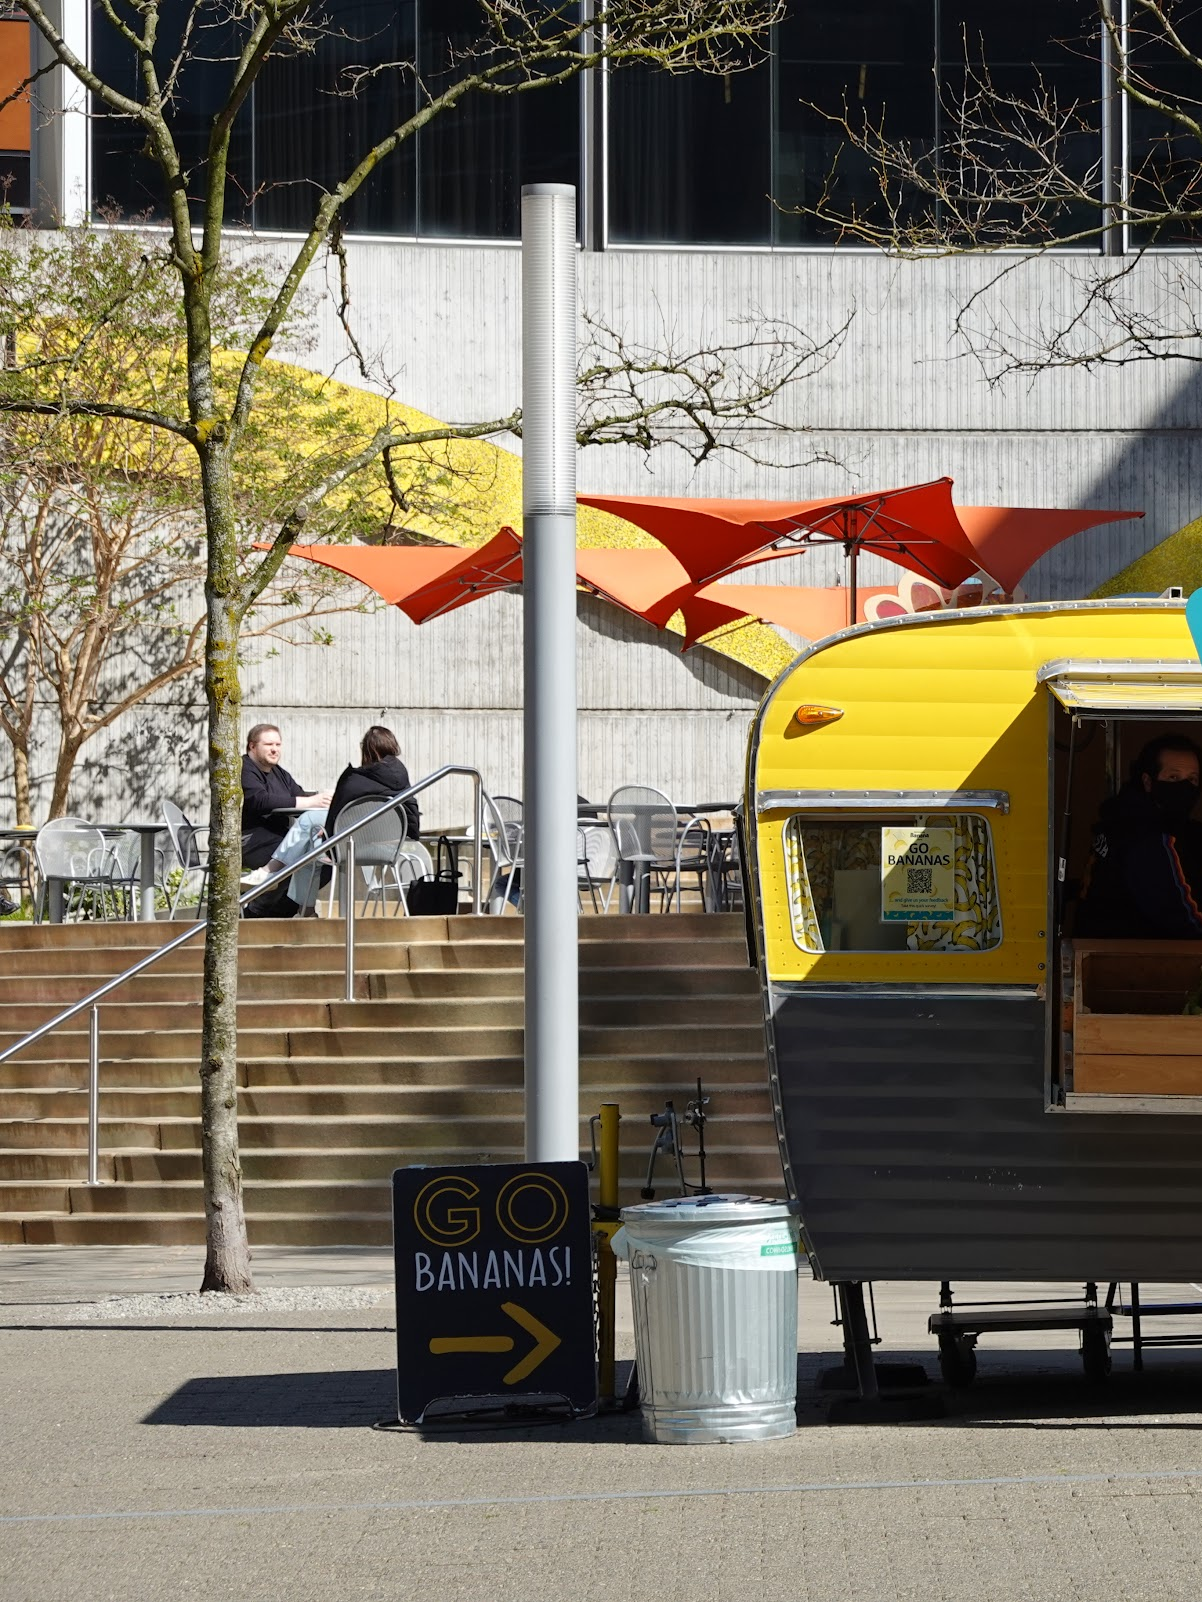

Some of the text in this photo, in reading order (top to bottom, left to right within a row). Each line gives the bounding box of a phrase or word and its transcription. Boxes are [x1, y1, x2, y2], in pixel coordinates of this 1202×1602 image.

[888, 855, 950, 866] BANANAS
[909, 843, 929, 854] GO
[414, 1172, 569, 1247] GO
[414, 1246, 571, 1292] BANANAS!
